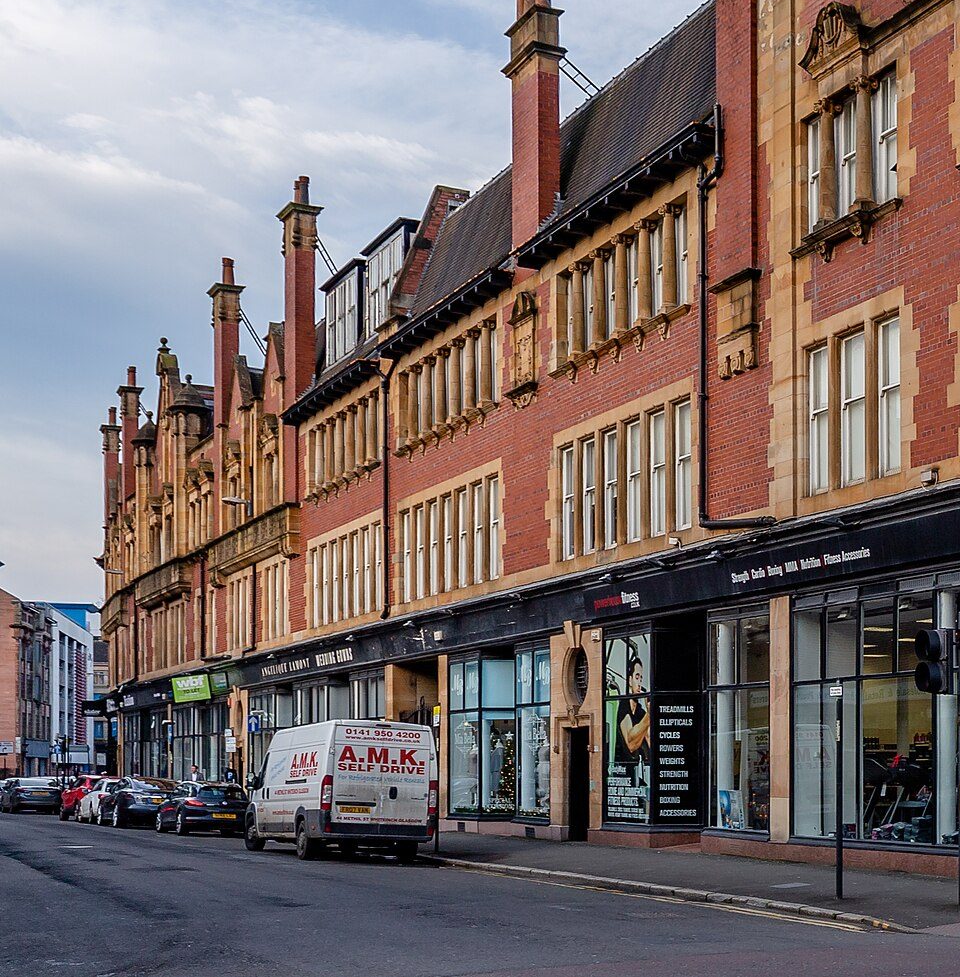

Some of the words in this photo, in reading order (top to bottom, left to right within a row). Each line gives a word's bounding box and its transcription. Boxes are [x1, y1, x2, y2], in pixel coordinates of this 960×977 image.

[731, 571, 749, 583] Strength
[751, 567, 765, 580] Cardio
[767, 565, 782, 576] Boxing
[785, 561, 798, 573] MMA
[800, 557, 821, 570] Nutrition
[823, 553, 841, 565] Fitness
[842, 547, 870, 562] Accessories
[659, 705, 694, 713] TREADMILLS
[659, 718, 693, 726] ELLIPTICALS
[346, 728, 370, 736] 0141
[374, 729, 393, 738] 950
[396, 731, 421, 739] 4200
[659, 731, 681, 739] CYCLES
[659, 744, 684, 752] ROWERS
[291, 751, 318, 769] A.M.K.
[338, 745, 425, 767] A.M.K.
[659, 757, 685, 765] WEIGHTS
[290, 769, 301, 778] SELF
[302, 767, 317, 777] DRIVE
[338, 762, 375, 773] SELF
[380, 764, 425, 775] DRIVE
[659, 770, 689, 778] STRENGTH
[659, 783, 689, 791] NUTRITION
[659, 796, 681, 804] BOXING
[659, 809, 697, 817] ACCESSORIES
